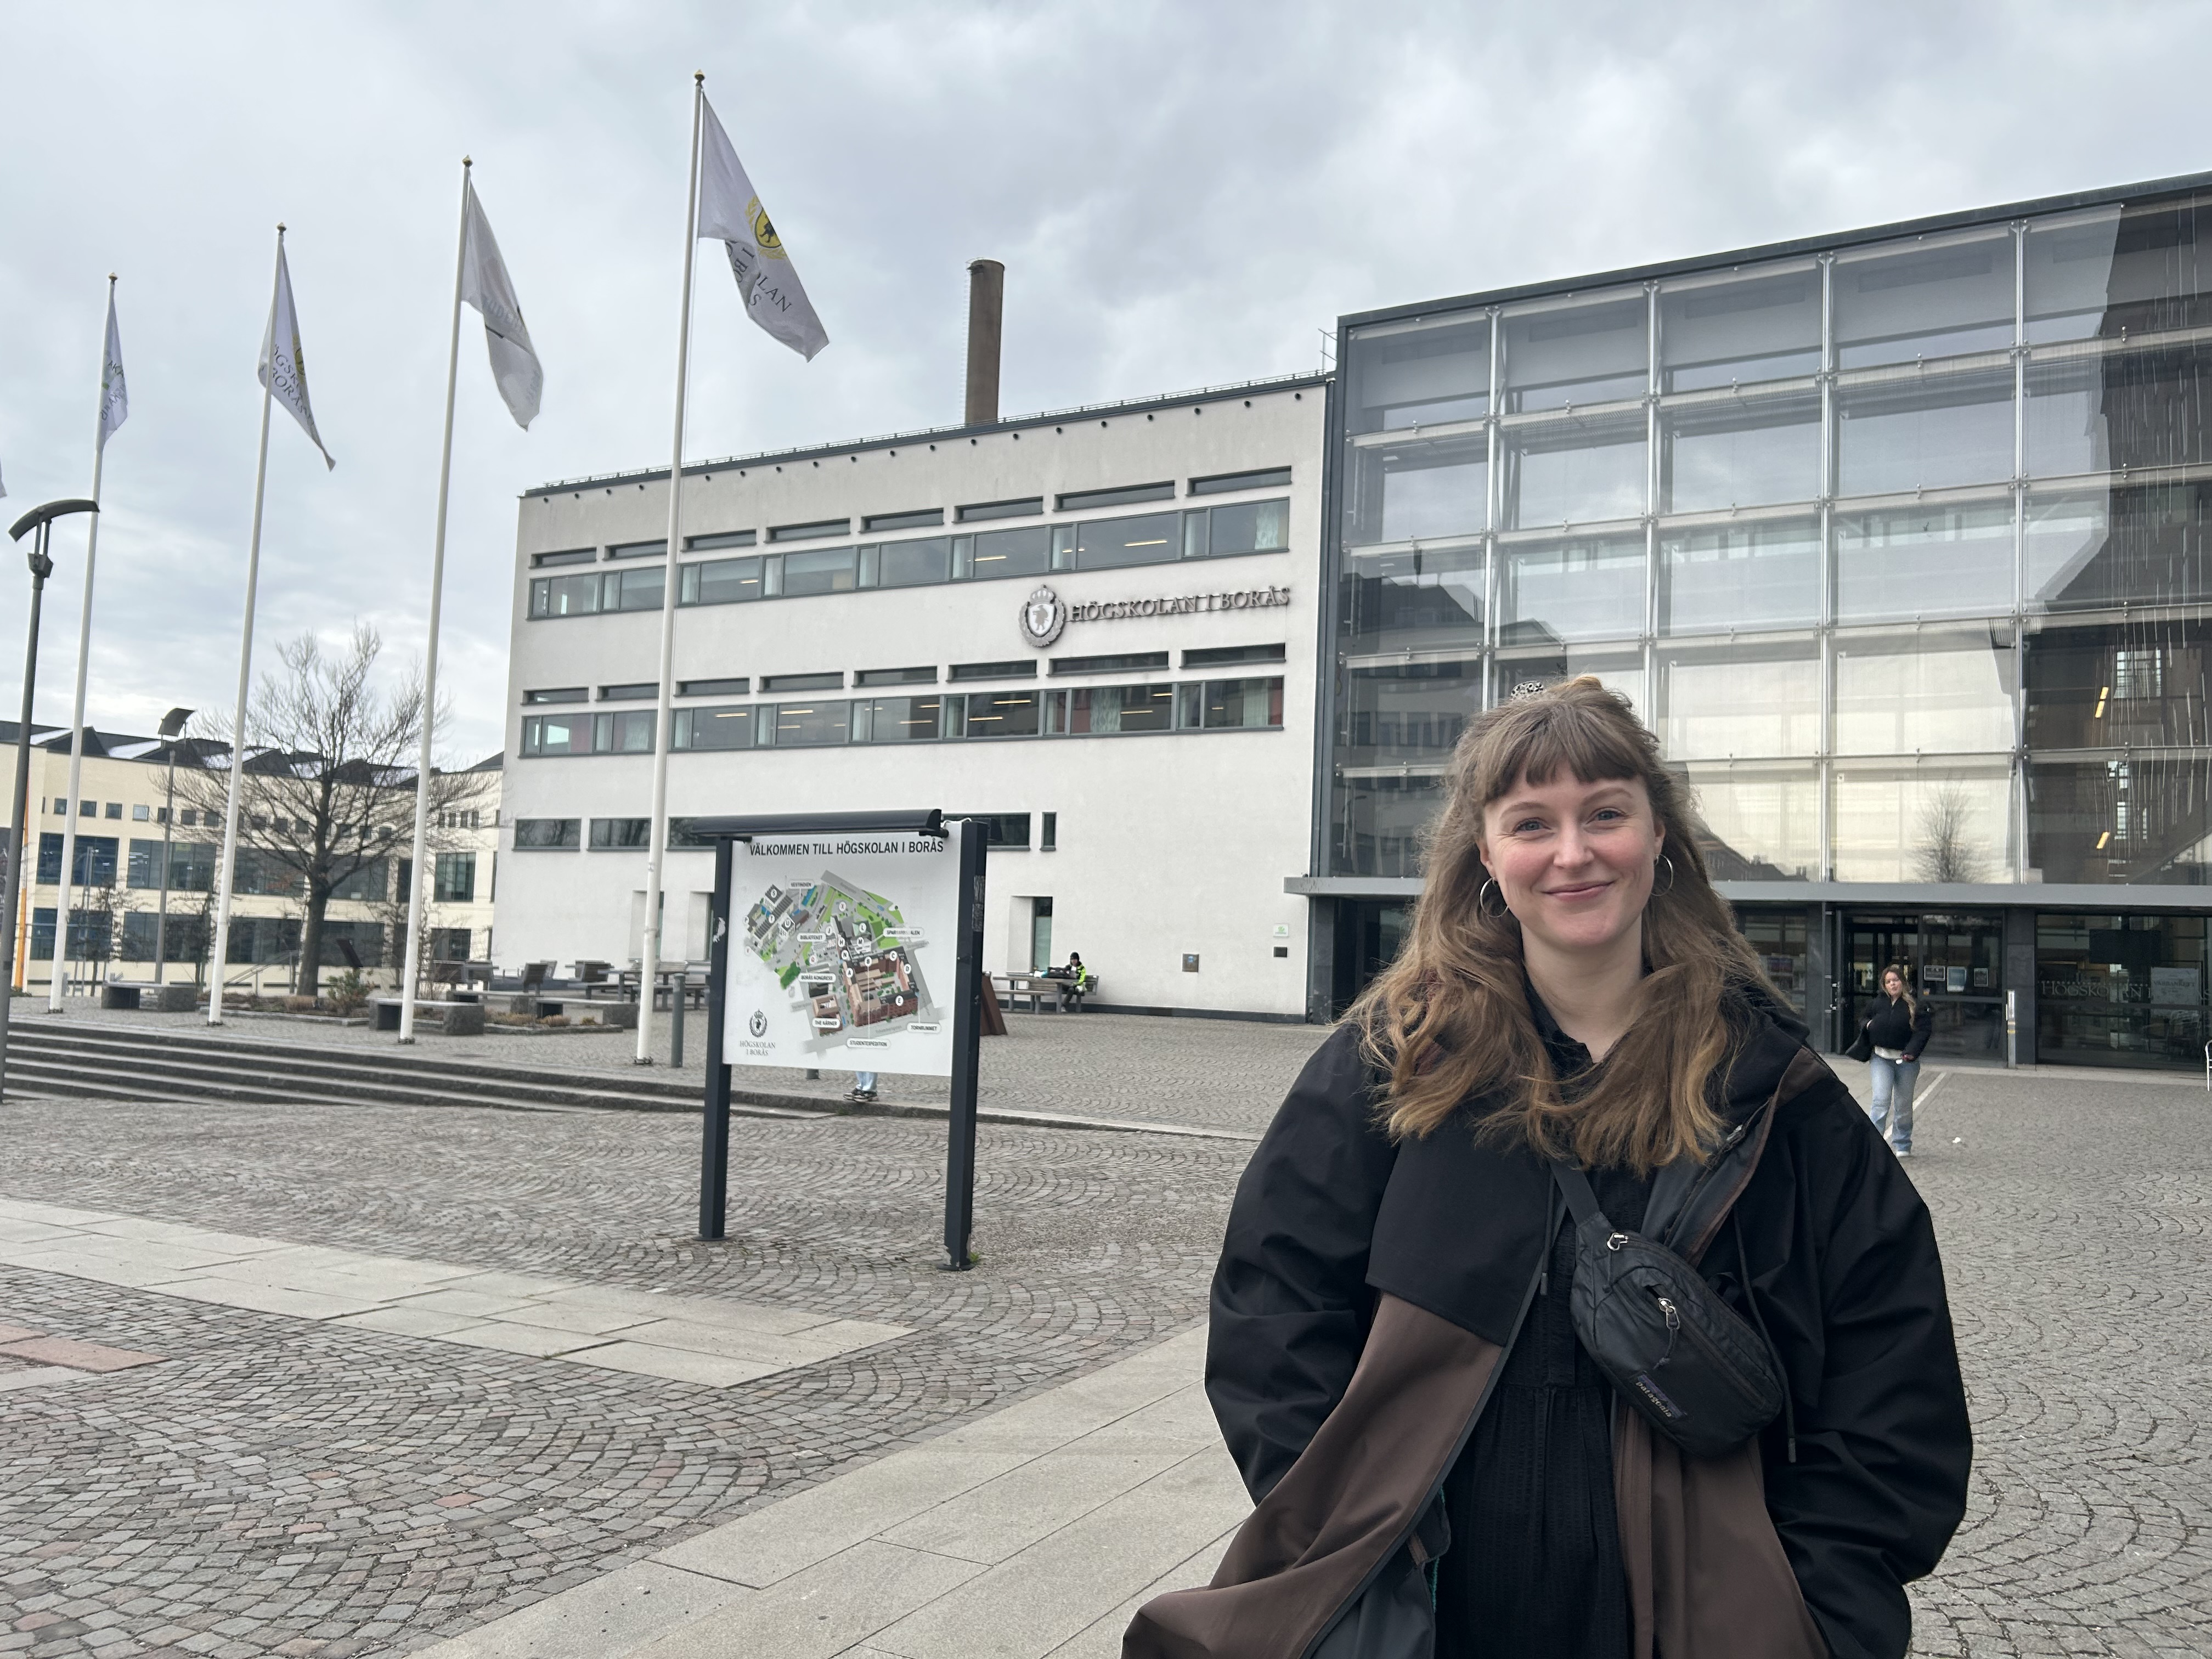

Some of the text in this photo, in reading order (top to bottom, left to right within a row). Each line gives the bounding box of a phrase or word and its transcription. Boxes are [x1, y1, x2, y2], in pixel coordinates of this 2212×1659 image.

[1071, 585, 1290, 622] HÖGSKOLAN I BORÅS
[749, 838, 944, 856] VÄLKOMMEN TILL HÖGSKOLAN I BORÅS
[1635, 1381, 1672, 1417] patagonia
